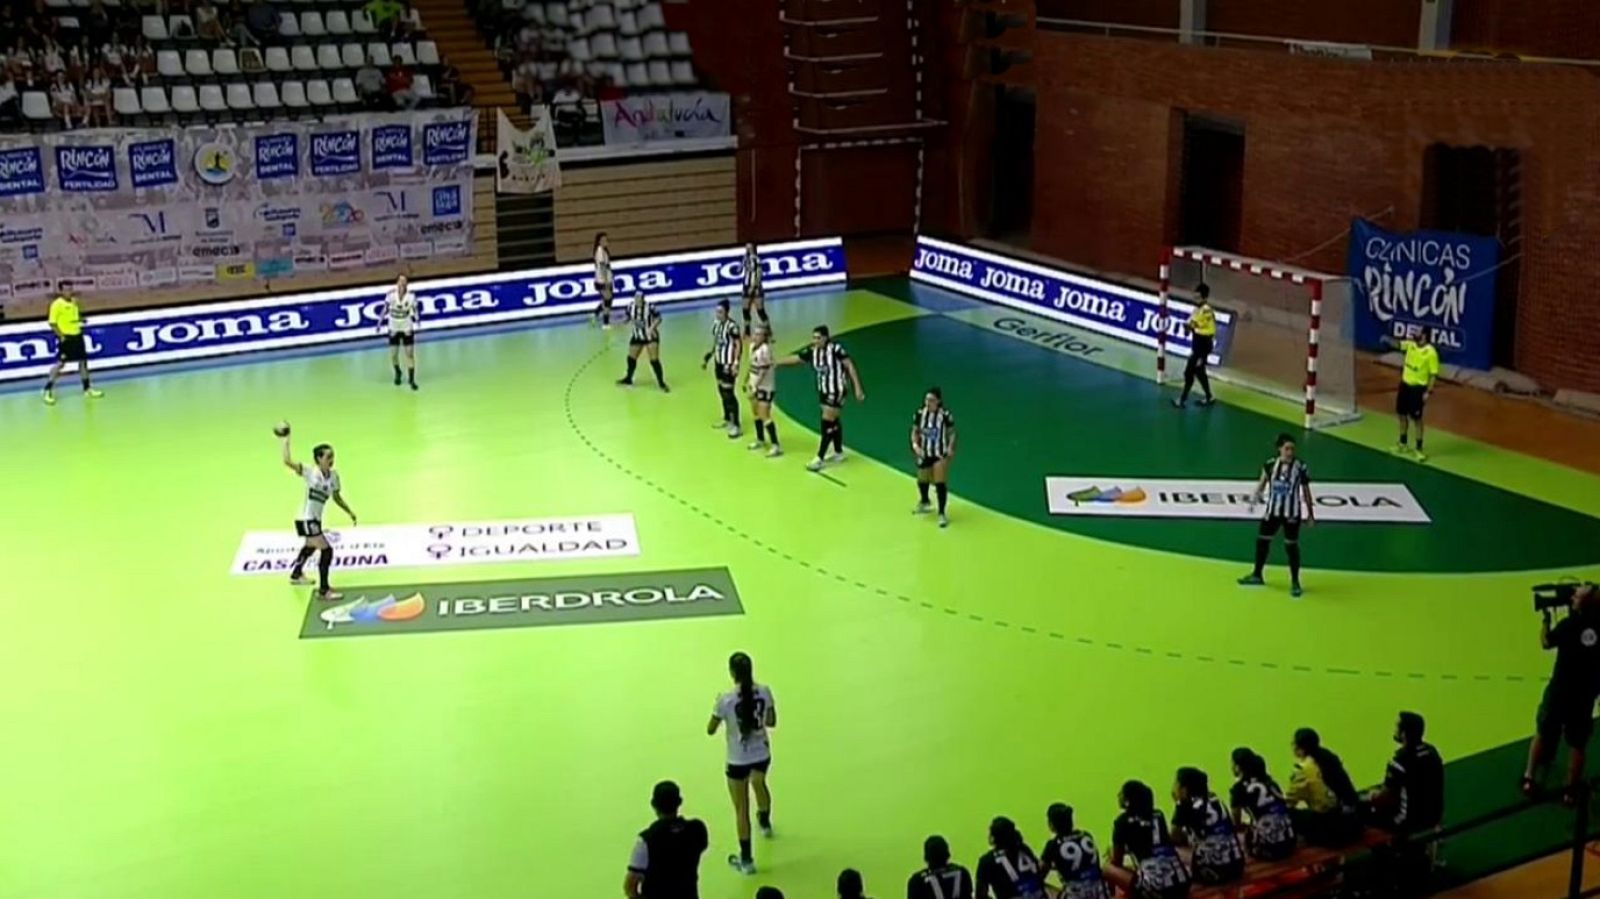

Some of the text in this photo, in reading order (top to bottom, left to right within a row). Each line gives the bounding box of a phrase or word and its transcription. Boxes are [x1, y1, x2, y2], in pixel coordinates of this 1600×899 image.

[614, 97, 721, 128] Andalucía
[914, 248, 974, 280] Joma
[980, 266, 1046, 301] Joma
[1054, 286, 1127, 322] Joma
[126, 309, 309, 350] Joma
[993, 316, 1105, 357] Gerflor
[1393, 322, 1462, 348] DETAL
[461, 520, 603, 538] DEPORTE
[458, 538, 629, 558] IGUALDAD
[436, 584, 725, 616] IBERDROLA
[994, 850, 1038, 882] 14
[1059, 835, 1098, 872] 99
[923, 870, 963, 899] 17
